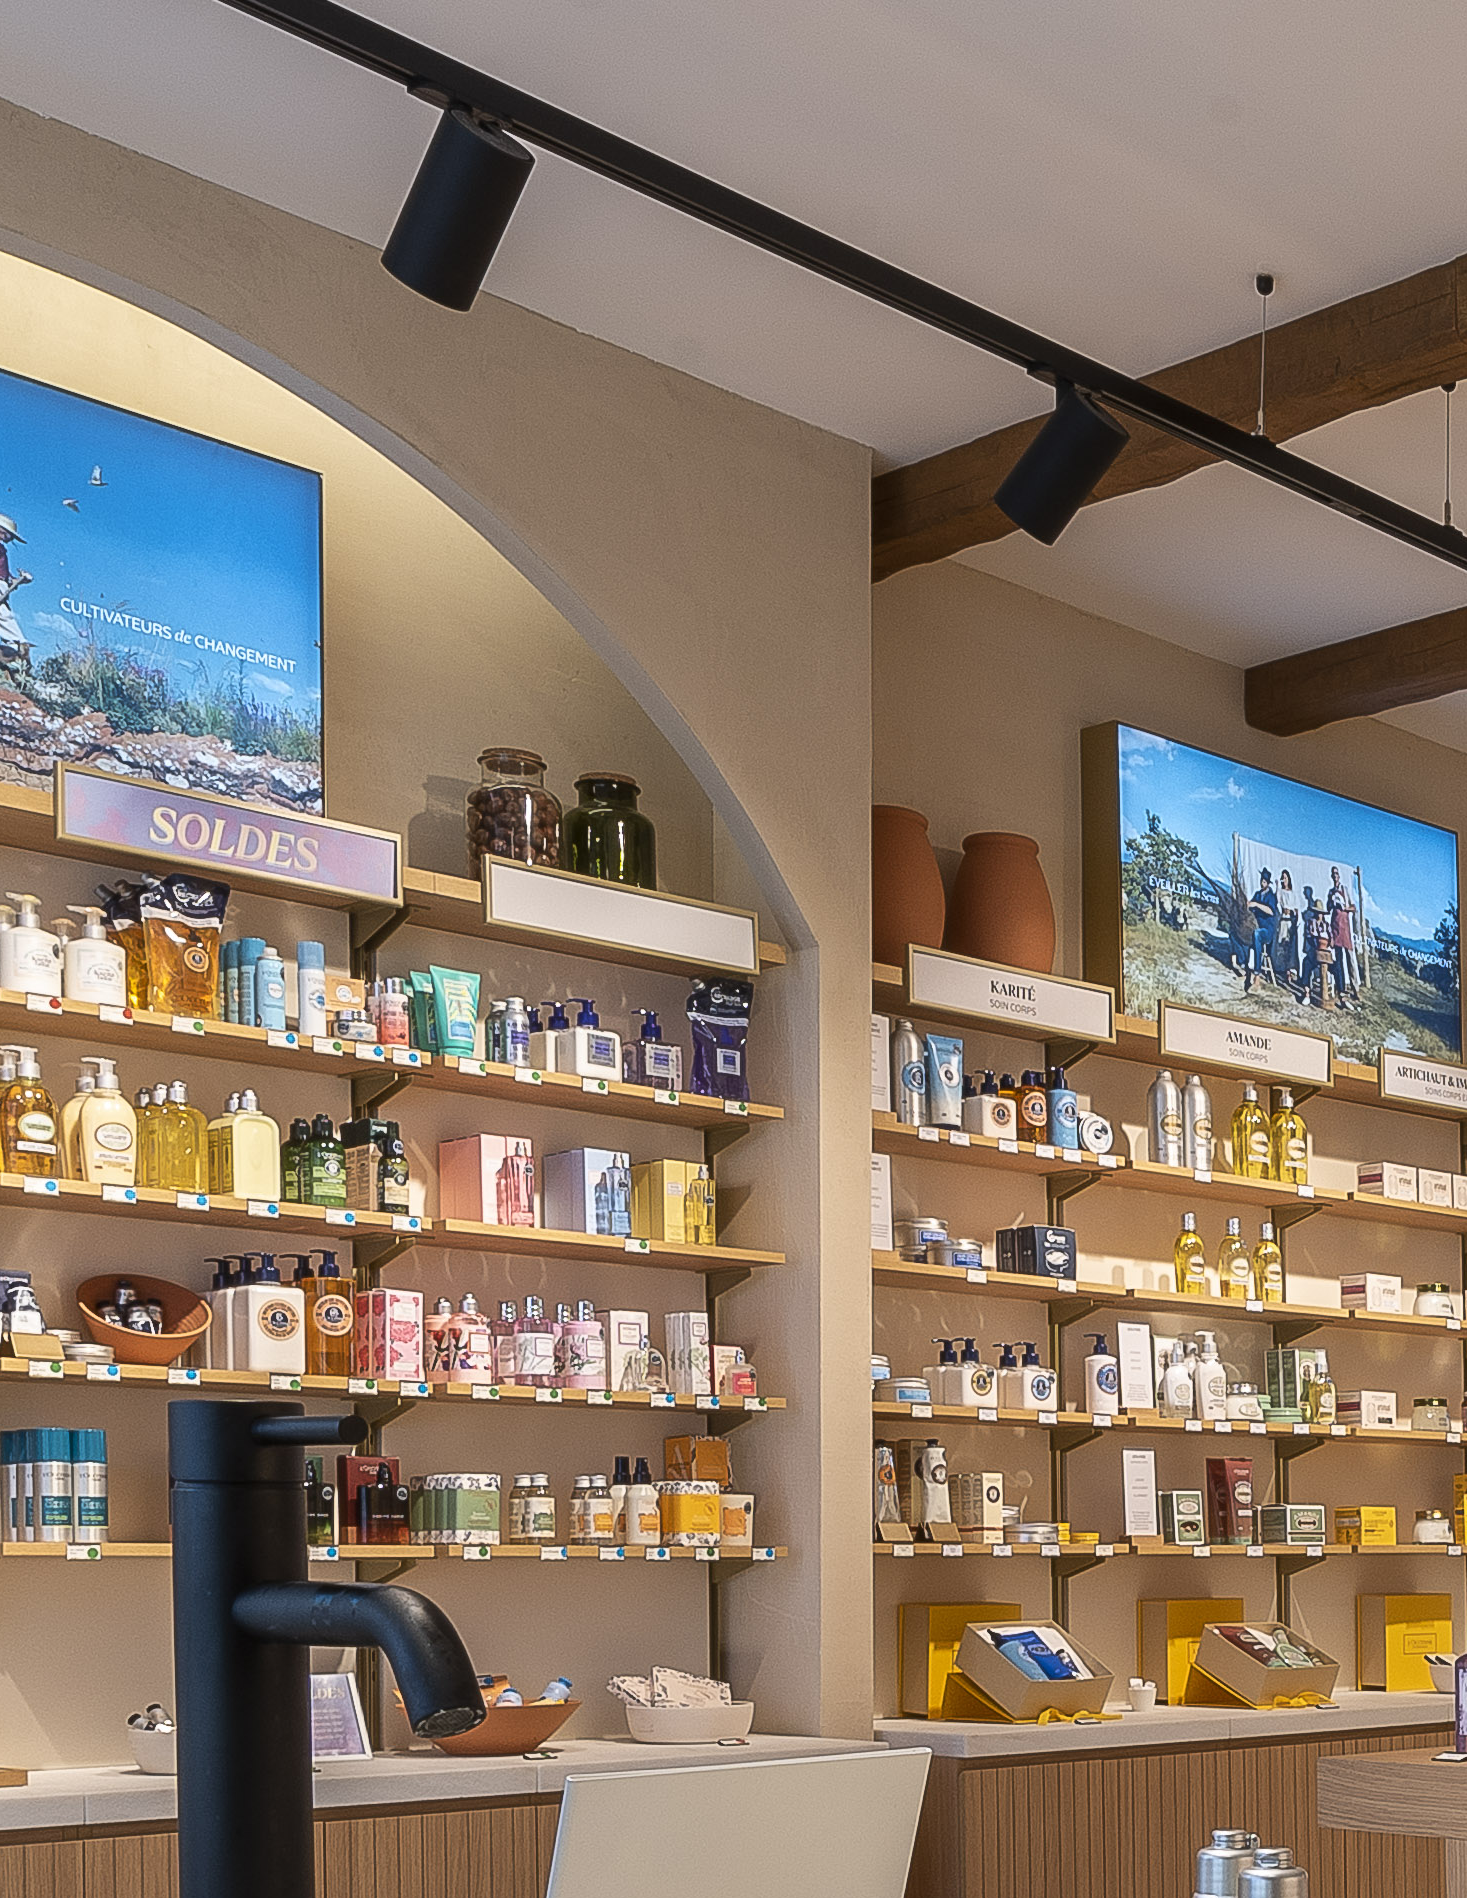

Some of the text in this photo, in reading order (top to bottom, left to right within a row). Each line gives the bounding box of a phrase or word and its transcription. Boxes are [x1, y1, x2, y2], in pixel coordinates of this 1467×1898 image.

[60, 597, 297, 674] CULTIVATEURS de CHANGEMENT
[149, 806, 319, 874] SOLDES
[1149, 874, 1189, 897] ÉVEILLER
[1408, 947, 1453, 969] CHANGEMENT
[990, 980, 1036, 1002] KARITÉ
[989, 998, 1037, 1017] SOIN CORPS
[1225, 1031, 1272, 1051] AMANDE
[1228, 1047, 1269, 1064] SOIN CORPS
[1395, 1065, 1447, 1087] ARTICHAUT
[1447, 1076, 1455, 1087] &
